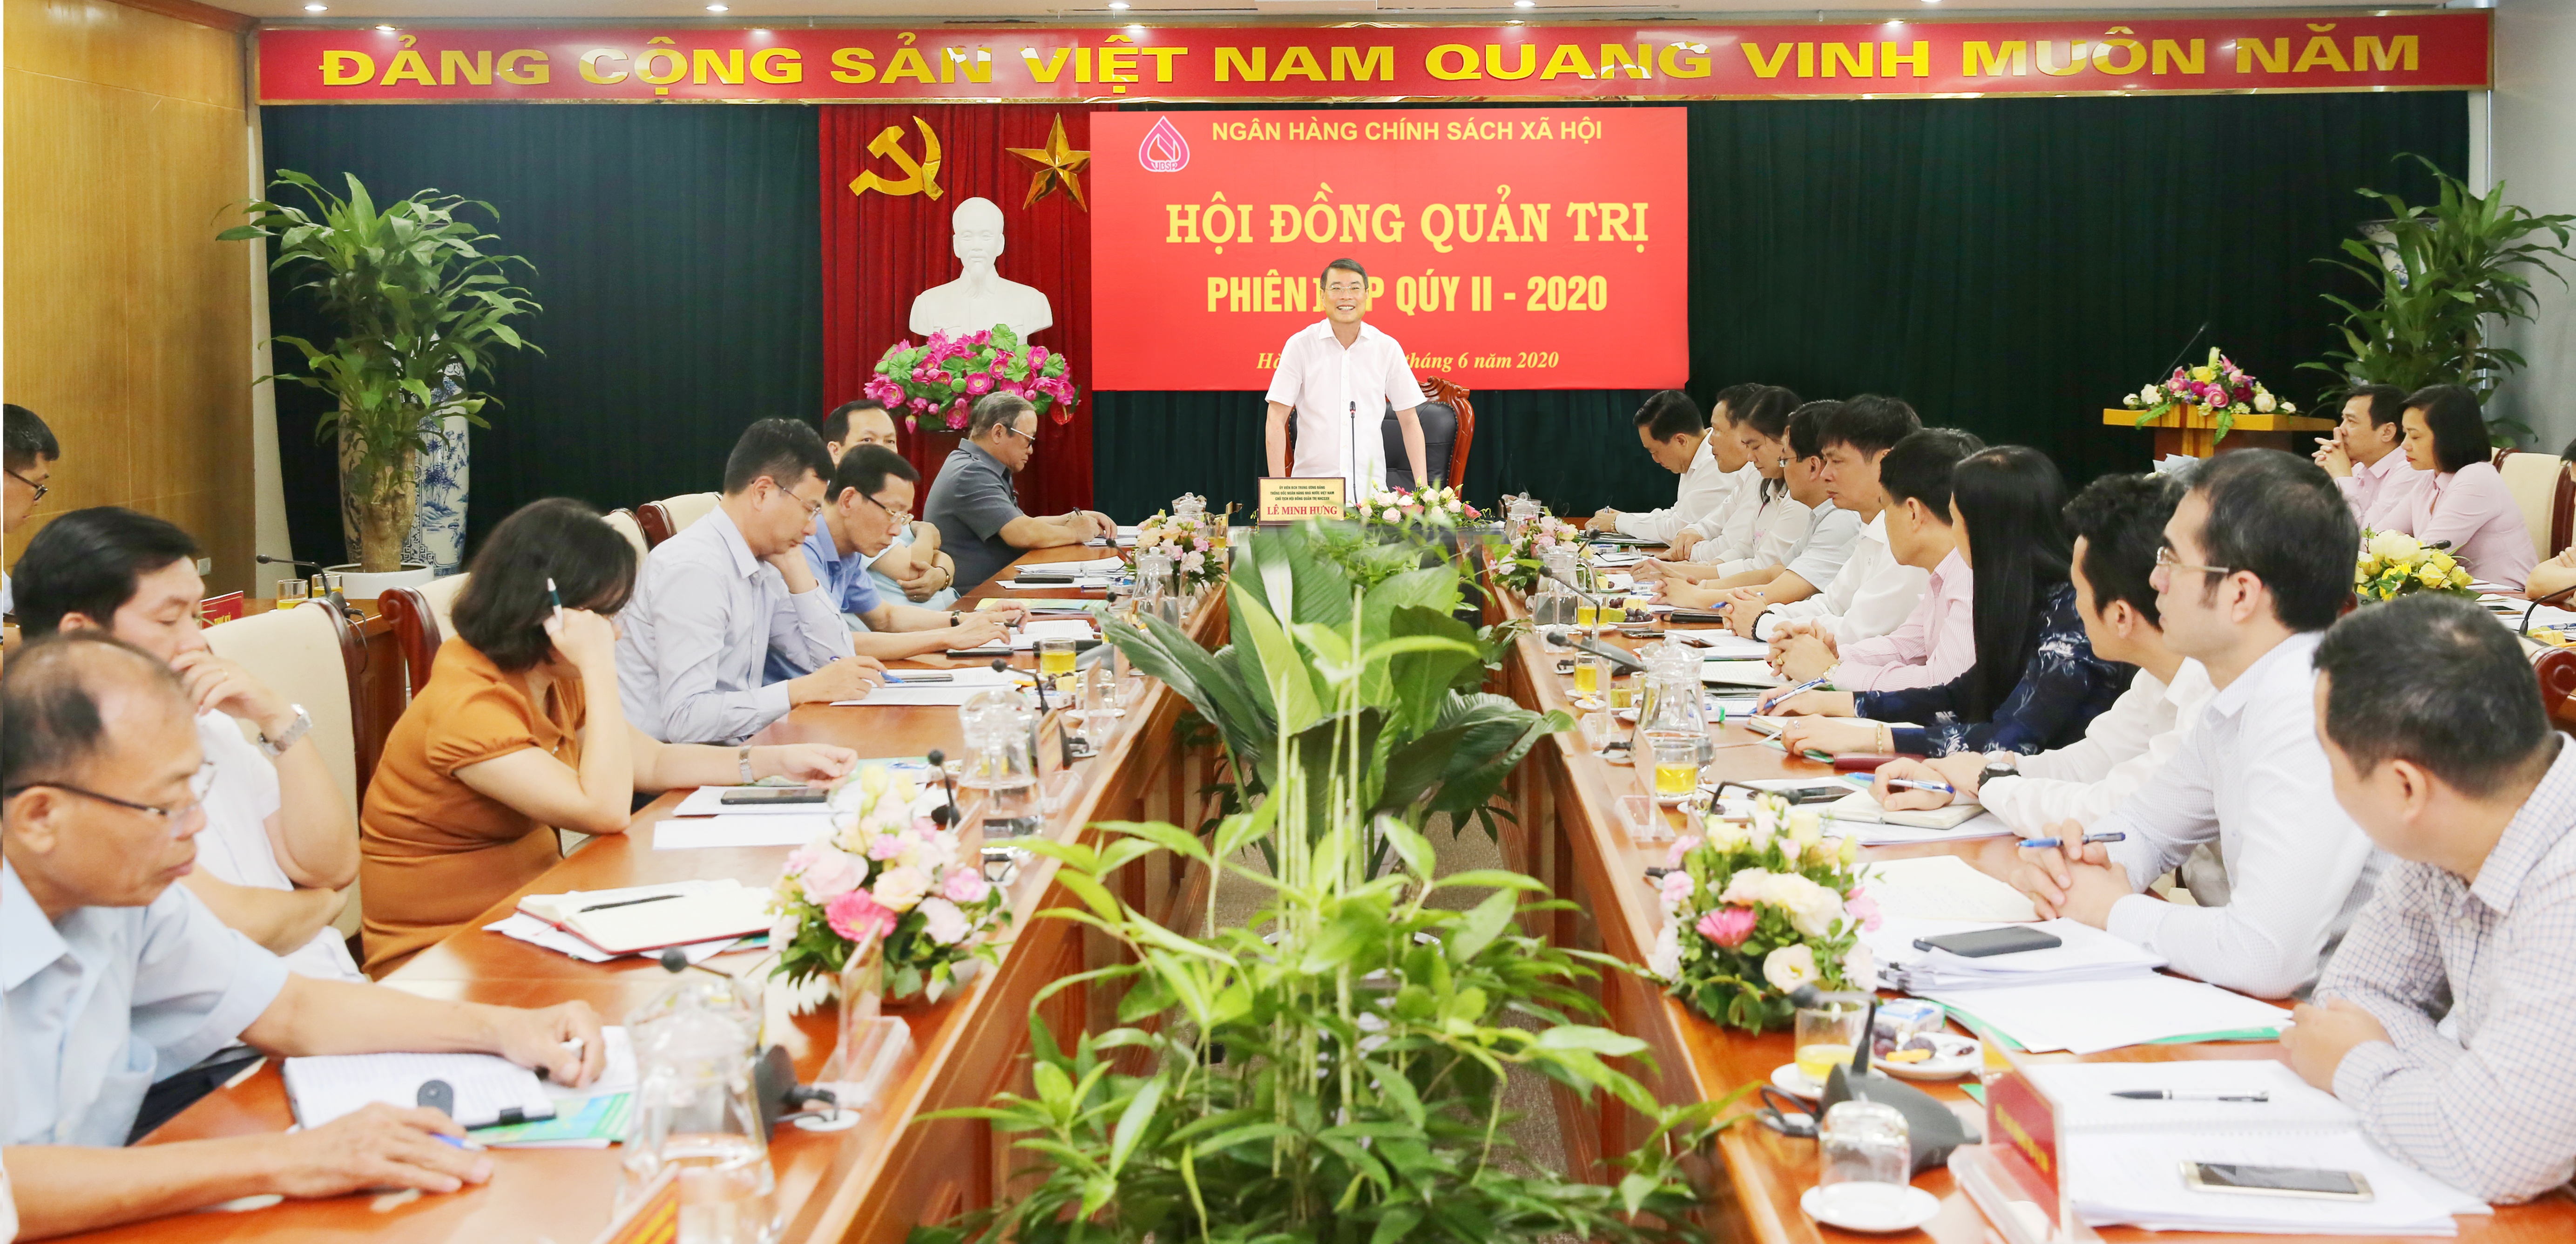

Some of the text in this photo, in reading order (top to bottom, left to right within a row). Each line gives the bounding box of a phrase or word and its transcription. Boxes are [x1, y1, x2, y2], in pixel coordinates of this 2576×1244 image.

[318, 23, 2419, 95] ĐẢNG CỘNG SẢN VIỆT NAM QUANG VINH MUÔN NĂM
[1212, 116, 1602, 144] NGÂN HÀNG CHÍNH SÁCH XÃ HỘI
[1165, 182, 1649, 255] HỘI ĐỒNG QUẢN TRỊ
[1207, 269, 1307, 313] PHIÊN
[1395, 268, 1460, 316] QÚY
[1471, 275, 1493, 312] II
[1503, 292, 1516, 300] -
[1527, 275, 1608, 312] 2020
[1458, 352, 1469, 369] 6
[1474, 353, 1512, 369] năm
[1516, 351, 1559, 369] 2020
[1267, 504, 1338, 515] LÊ MINH HƯNG
